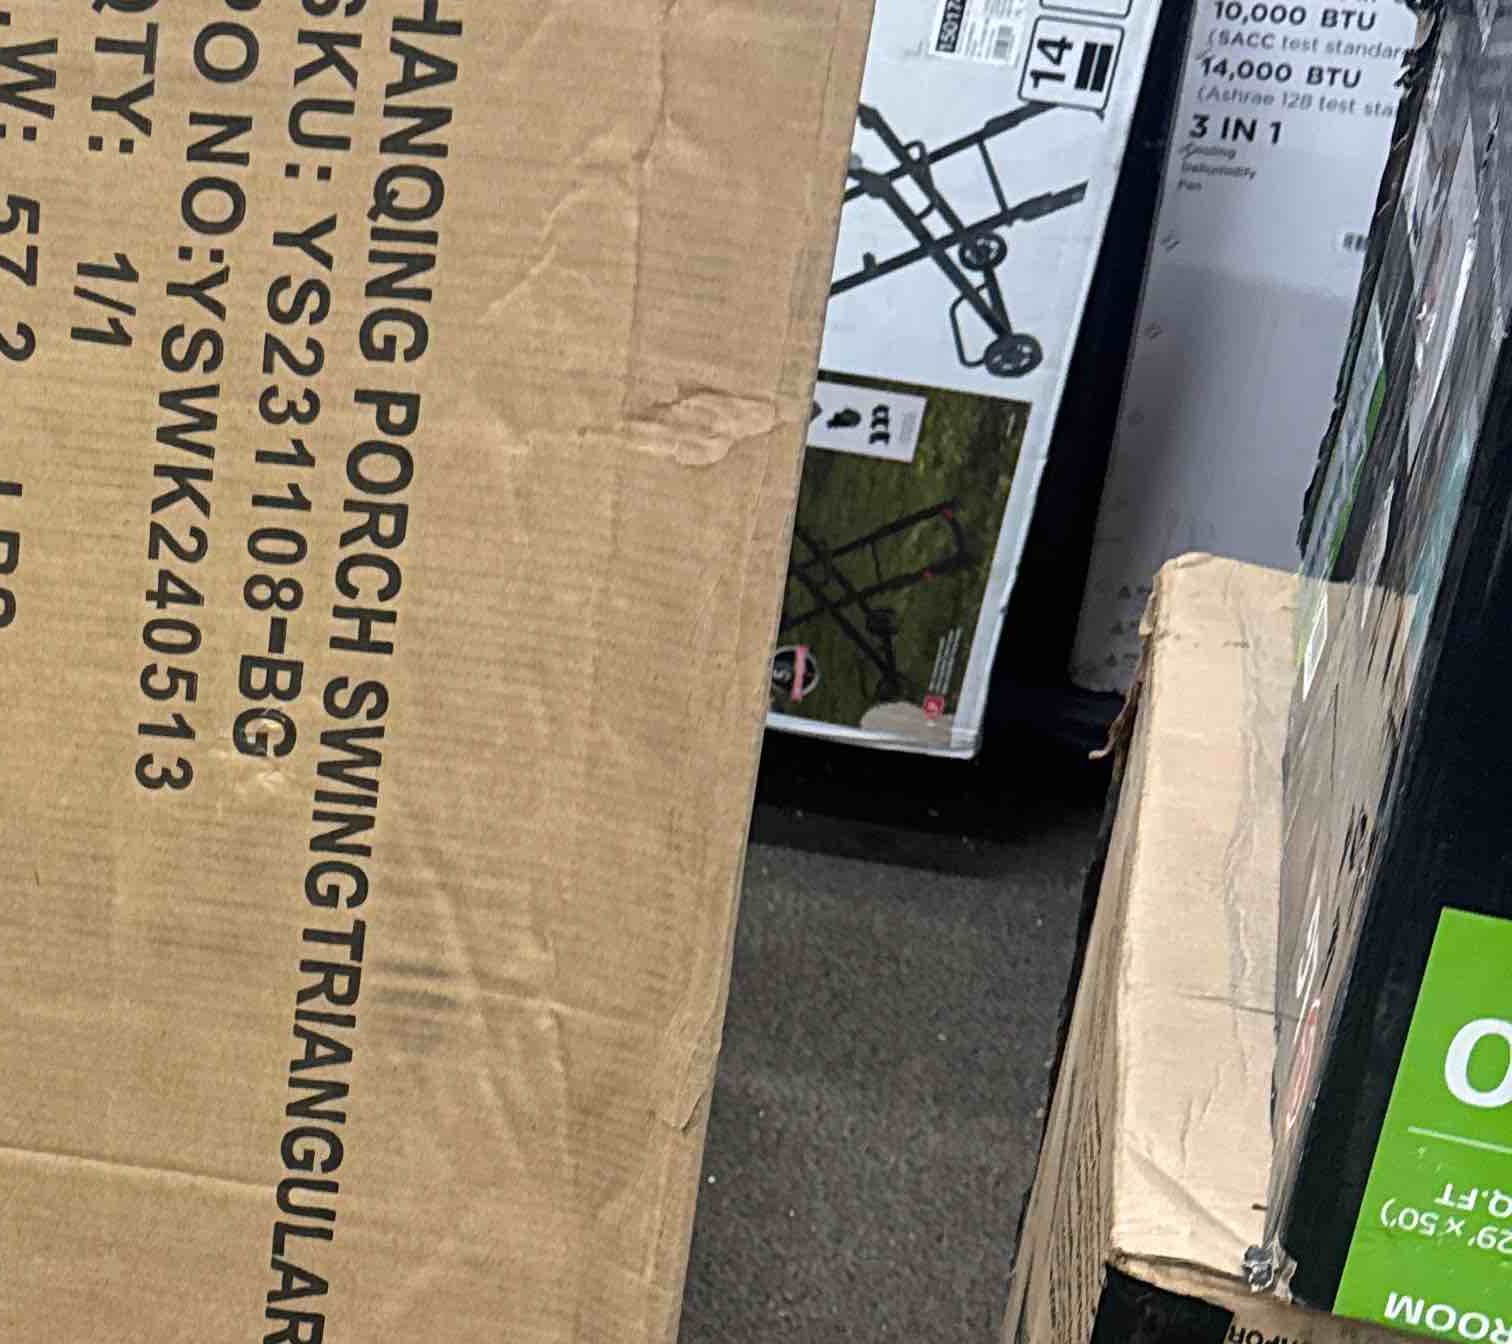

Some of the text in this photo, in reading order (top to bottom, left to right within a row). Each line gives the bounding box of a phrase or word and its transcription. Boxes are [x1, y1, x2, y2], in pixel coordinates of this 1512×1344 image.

[1215, 0, 1377, 31] 10,000 BTU
[1282, 35, 1319, 52] test
[1030, 36, 1074, 89] 14
[1201, 57, 1362, 88] 14,000 BTU
[1319, 96, 1356, 113] test
[1189, 114, 1282, 144] 3 IN 1
[70, 251, 139, 349] 1/1
[232, 213, 338, 758] YS231108-BG
[327, 389, 421, 655] PORCH
